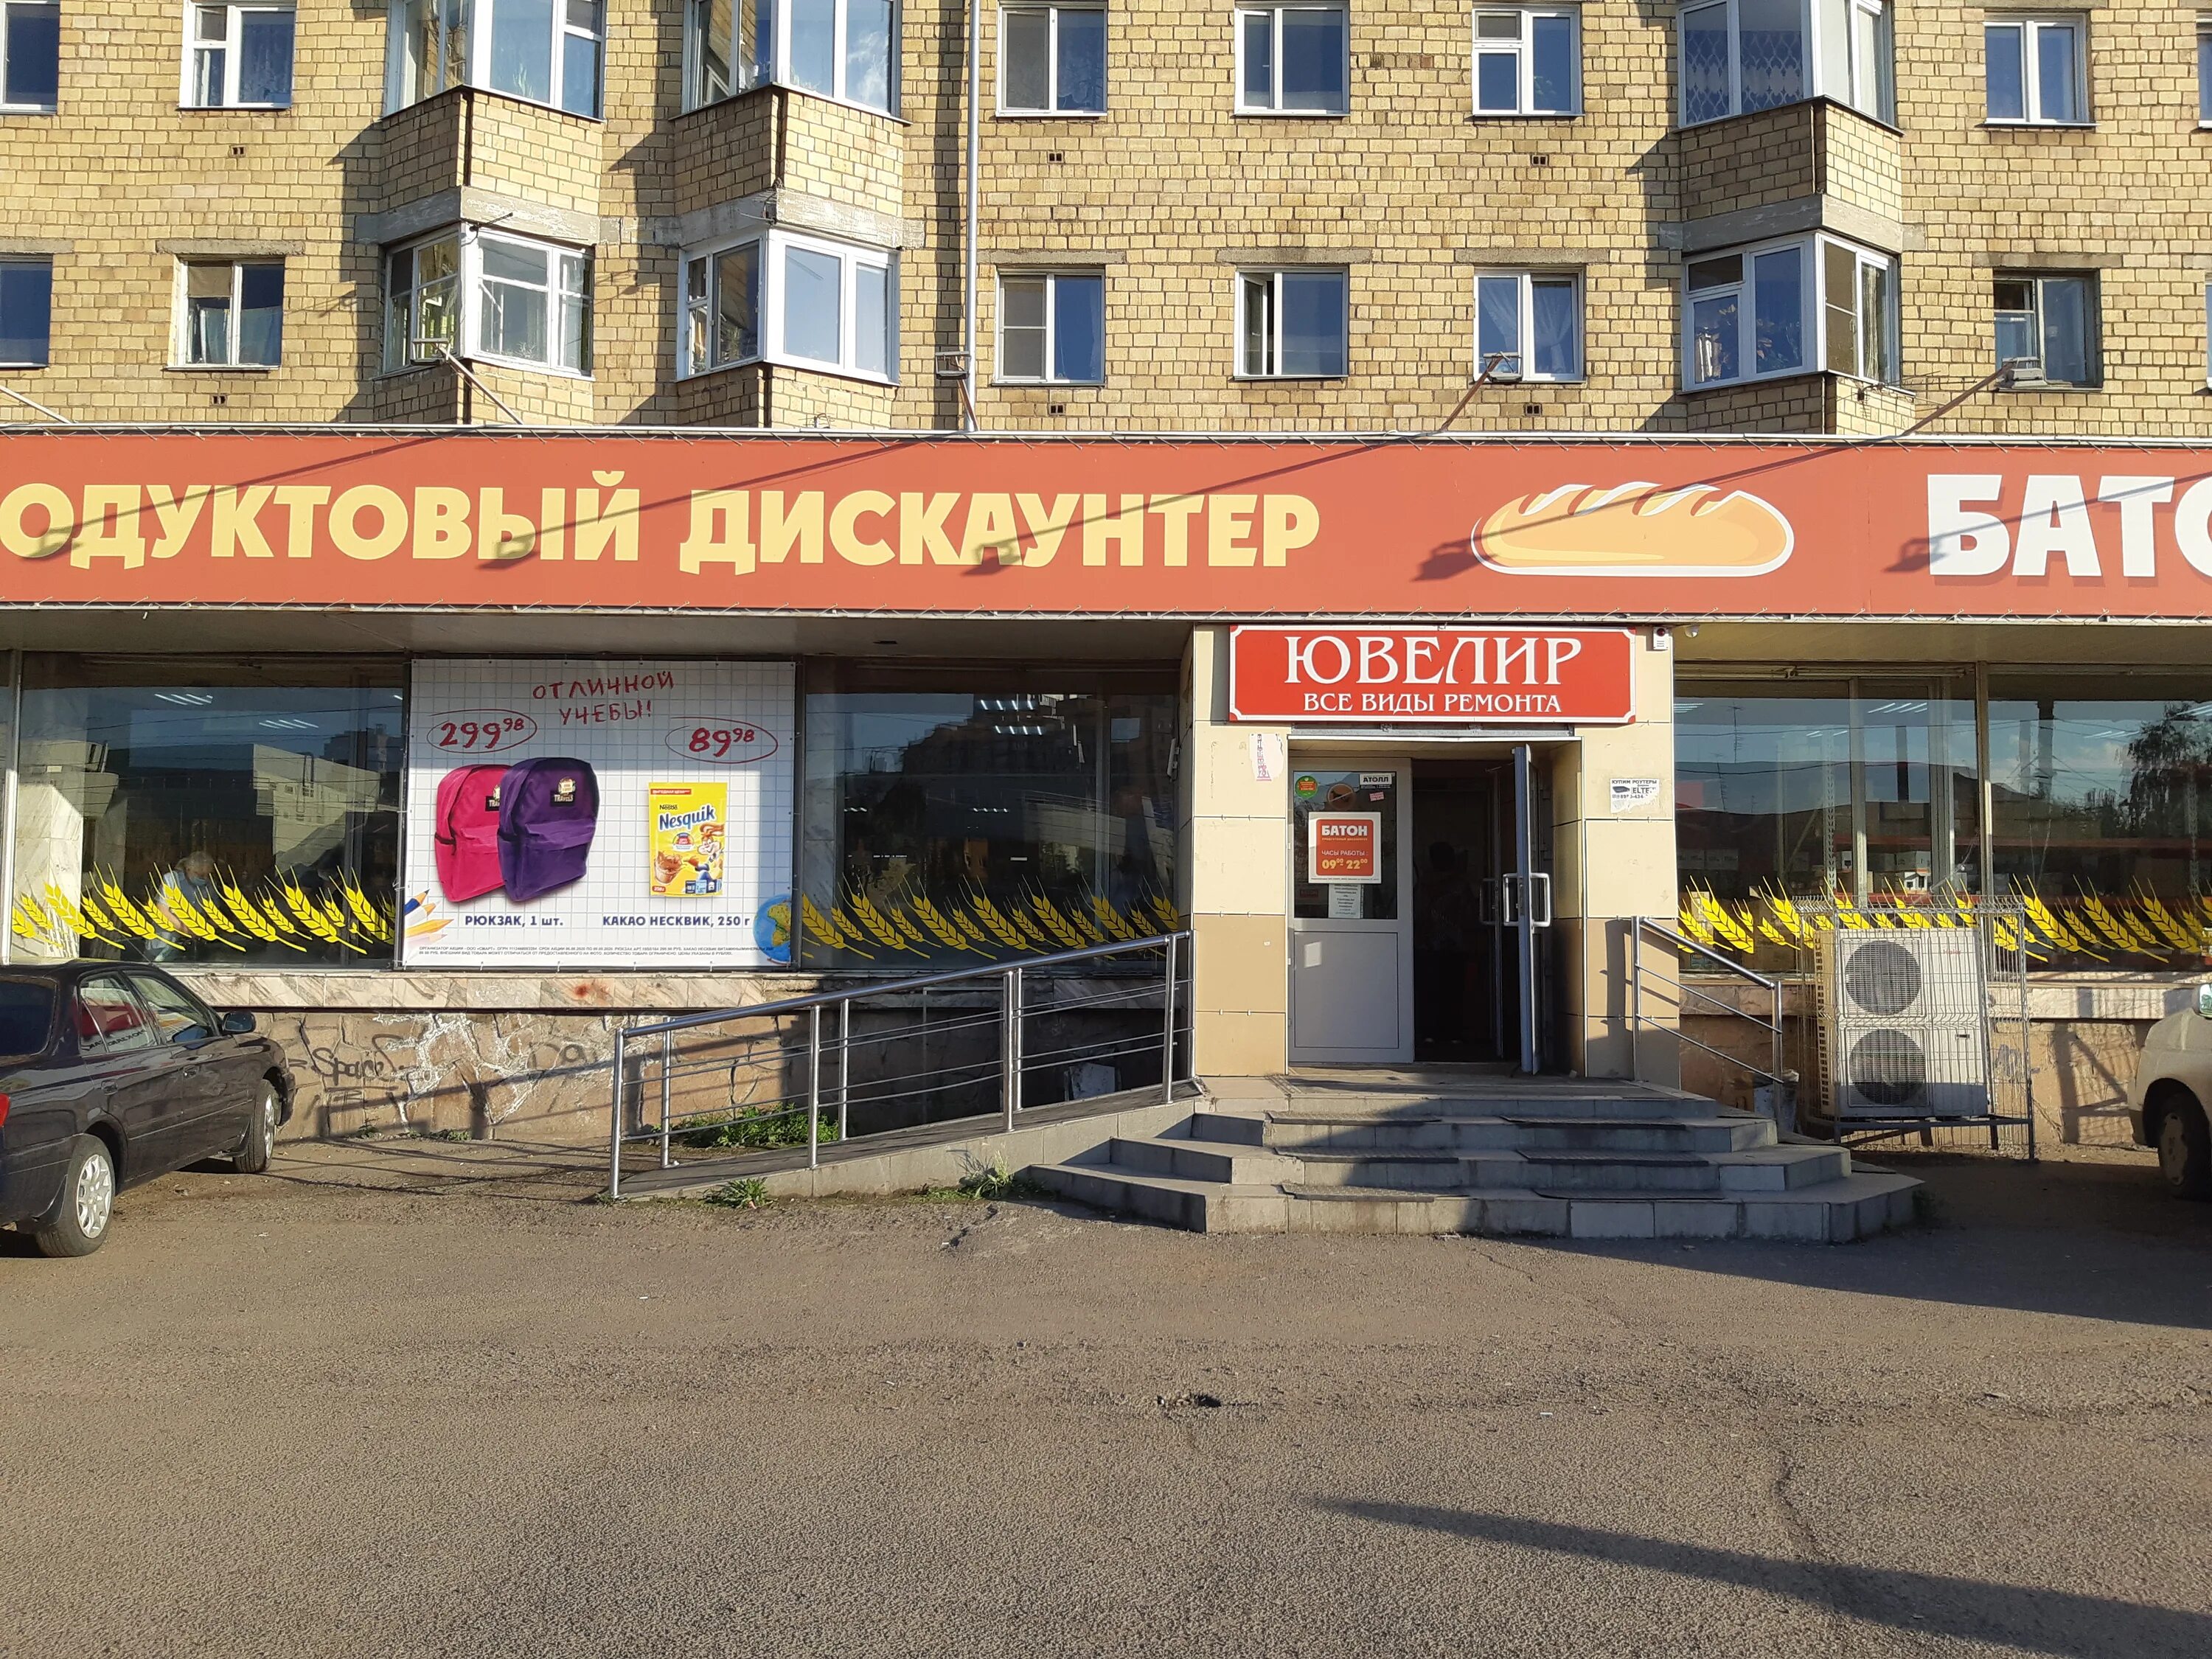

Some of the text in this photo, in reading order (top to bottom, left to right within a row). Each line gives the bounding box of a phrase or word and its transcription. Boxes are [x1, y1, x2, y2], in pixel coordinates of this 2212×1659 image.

[680, 490, 1320, 575] ДИСКАУНТЕР
[1284, 636, 1582, 686] ЮВЕЛИР
[532, 670, 675, 700] ОТЛИЧНОЙ
[558, 700, 652, 726] УЧЕБЫ!
[1304, 694, 1562, 716] ВСЕ ВИДЫ РЕМОНТА
[659, 804, 715, 830] Nesquik
[1321, 825, 1368, 837] БАТОН
[465, 916, 564, 928] РЮКЗАК, 1 шт.
[602, 916, 750, 928] КАКАО НЕСКВИК, 250 г
